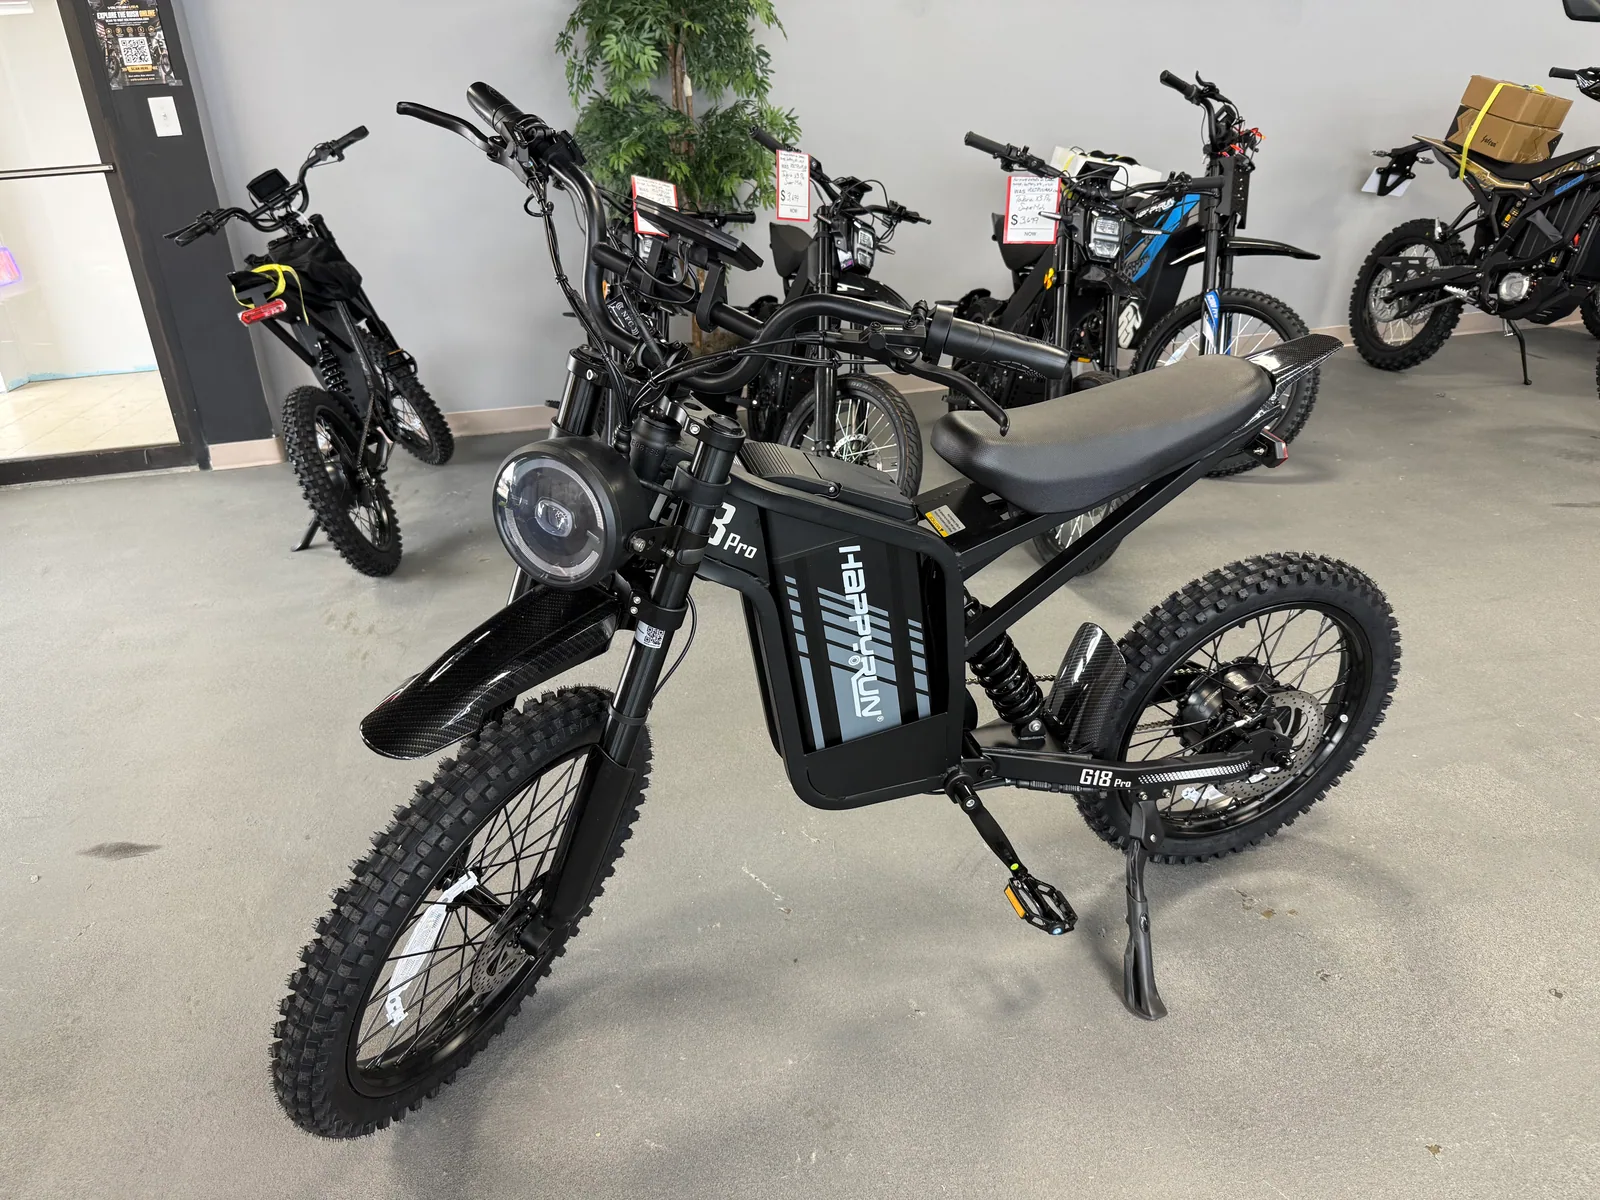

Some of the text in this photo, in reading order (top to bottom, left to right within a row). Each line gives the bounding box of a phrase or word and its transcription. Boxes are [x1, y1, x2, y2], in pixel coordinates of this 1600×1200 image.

[621, 310, 635, 327] NFC
[723, 532, 758, 559] Pro
[1080, 769, 1131, 788] G18 Pro
